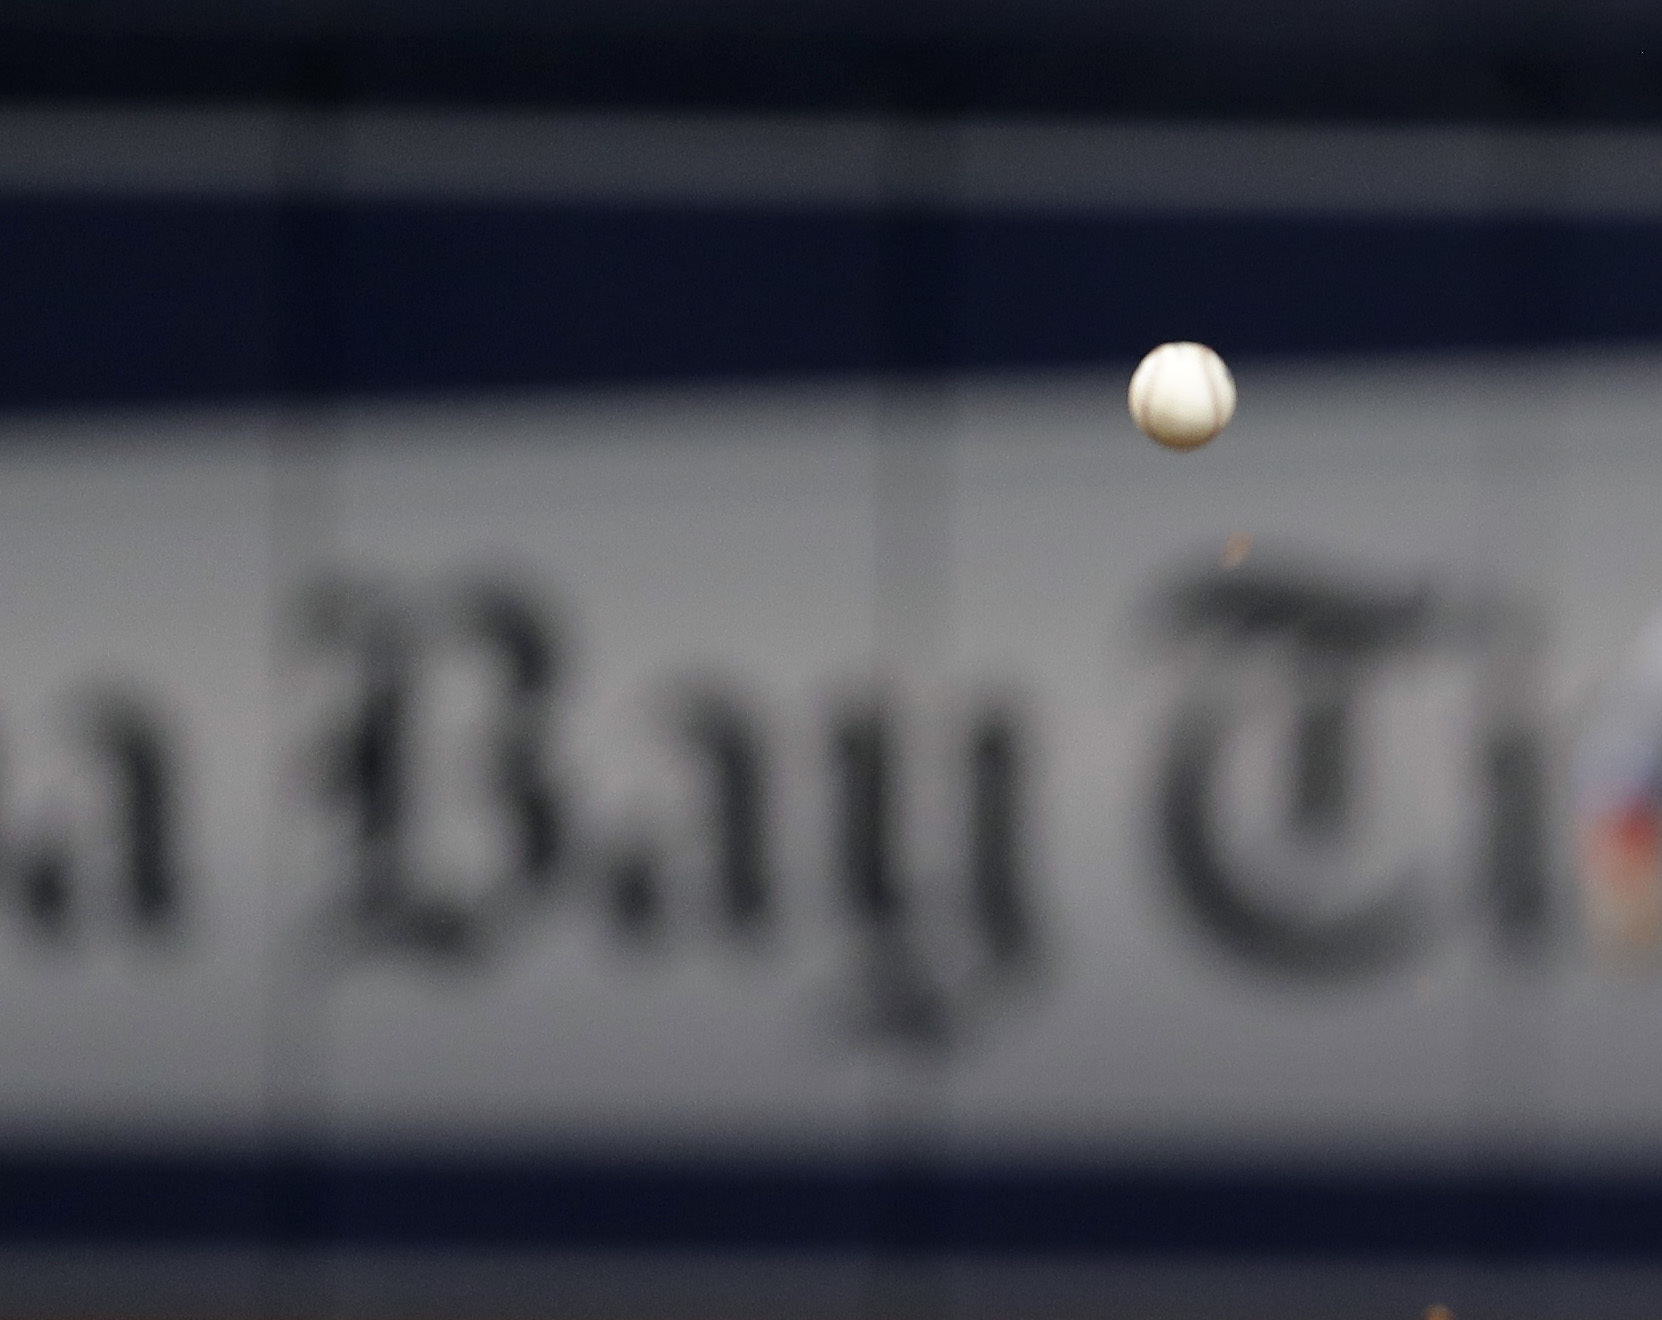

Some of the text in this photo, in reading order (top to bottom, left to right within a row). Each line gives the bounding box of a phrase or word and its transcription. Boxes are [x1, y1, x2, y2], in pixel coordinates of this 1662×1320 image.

[0, 540, 1548, 1055] a Bay Ti
